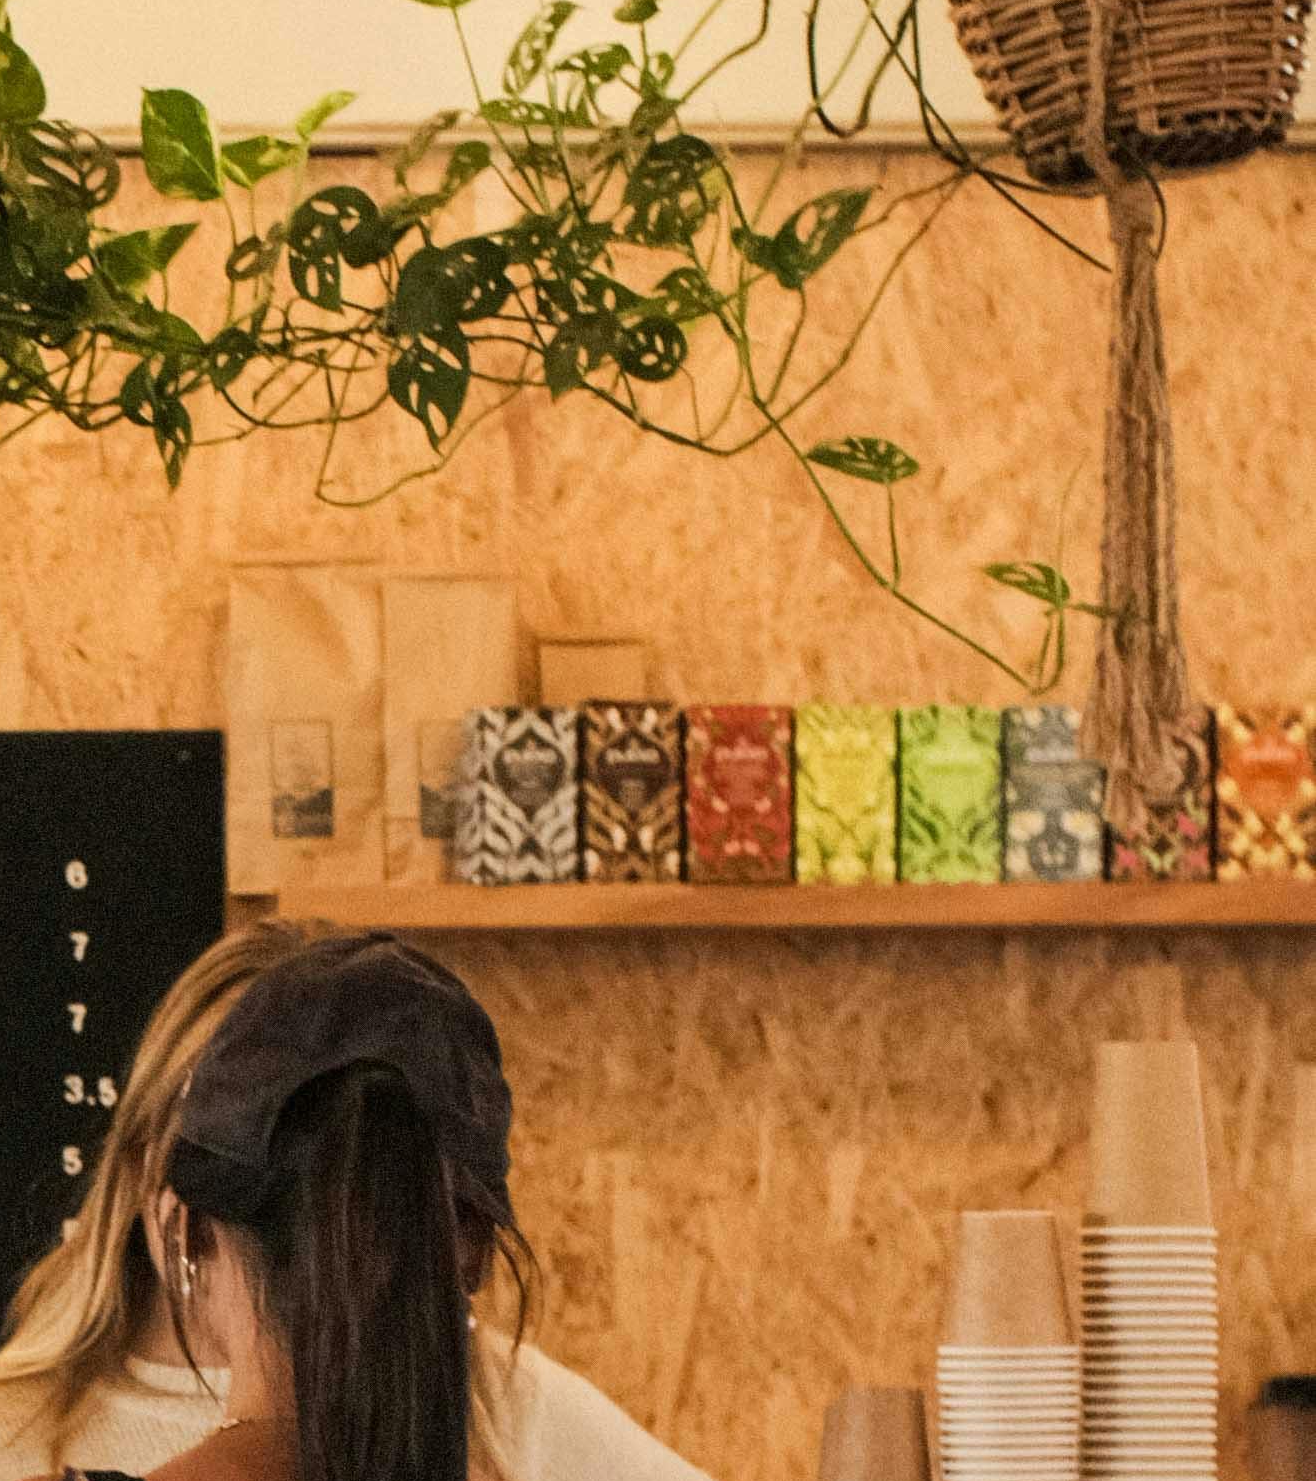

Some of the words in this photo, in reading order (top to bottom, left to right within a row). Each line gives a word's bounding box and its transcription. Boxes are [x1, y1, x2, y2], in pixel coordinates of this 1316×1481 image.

[65, 860, 88, 890] 6
[70, 931, 89, 961] 7
[68, 1003, 87, 1033] 7
[64, 1074, 118, 1108] 3.5
[62, 1145, 83, 1176] 5
